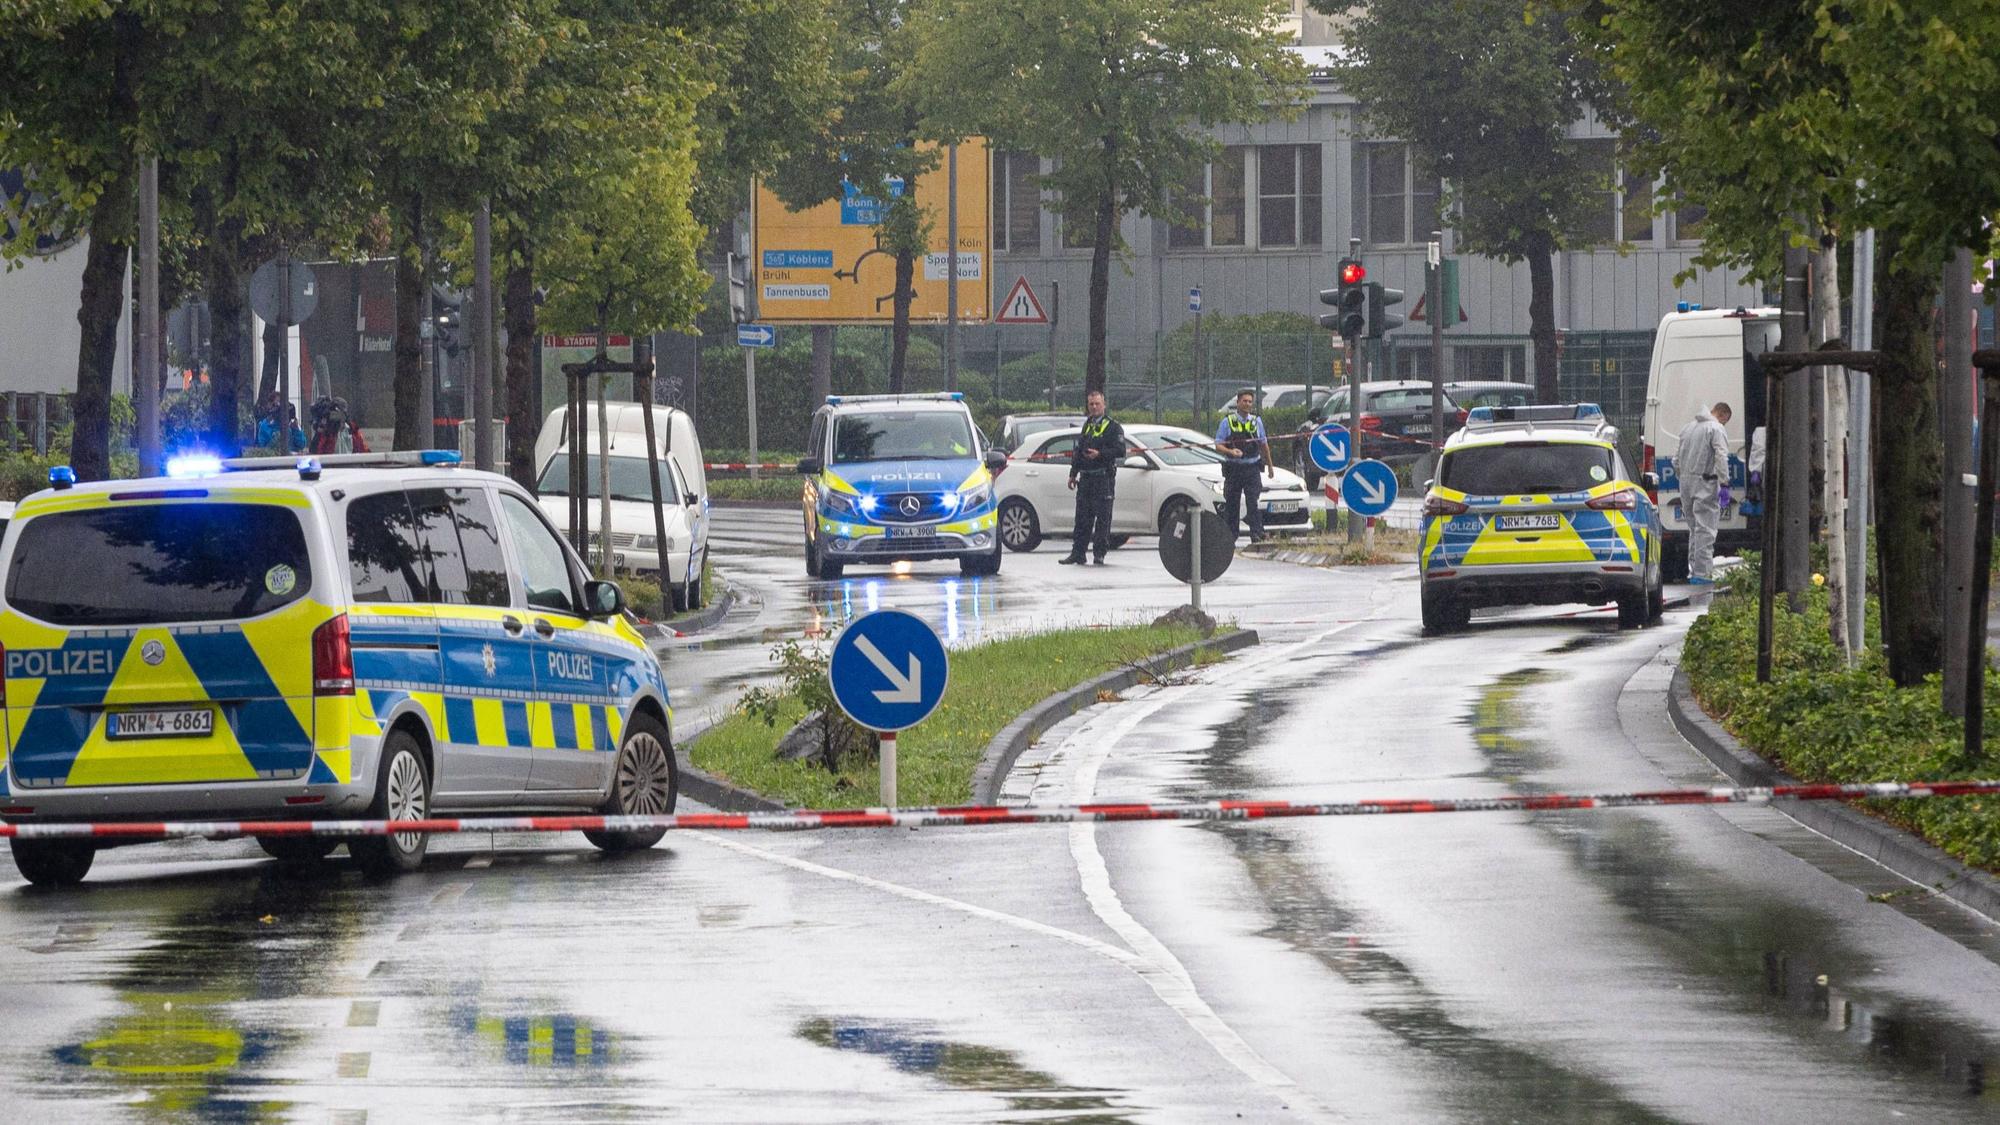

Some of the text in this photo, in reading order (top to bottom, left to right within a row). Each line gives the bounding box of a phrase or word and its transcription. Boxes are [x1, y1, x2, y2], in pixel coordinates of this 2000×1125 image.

[847, 197, 873, 207] Bonn
[959, 238, 982, 247] Köln
[788, 254, 830, 265] Koblenz
[762, 270, 791, 280] Brühl
[765, 286, 829, 297] Tannenbusch
[871, 473, 941, 482] POLIZEI
[1444, 521, 1481, 532] POLIZEI
[1501, 516, 1519, 527] NRW
[7, 650, 114, 676] POLIZEI
[547, 651, 594, 681] POLIZEI
[117, 715, 147, 733] NRW
